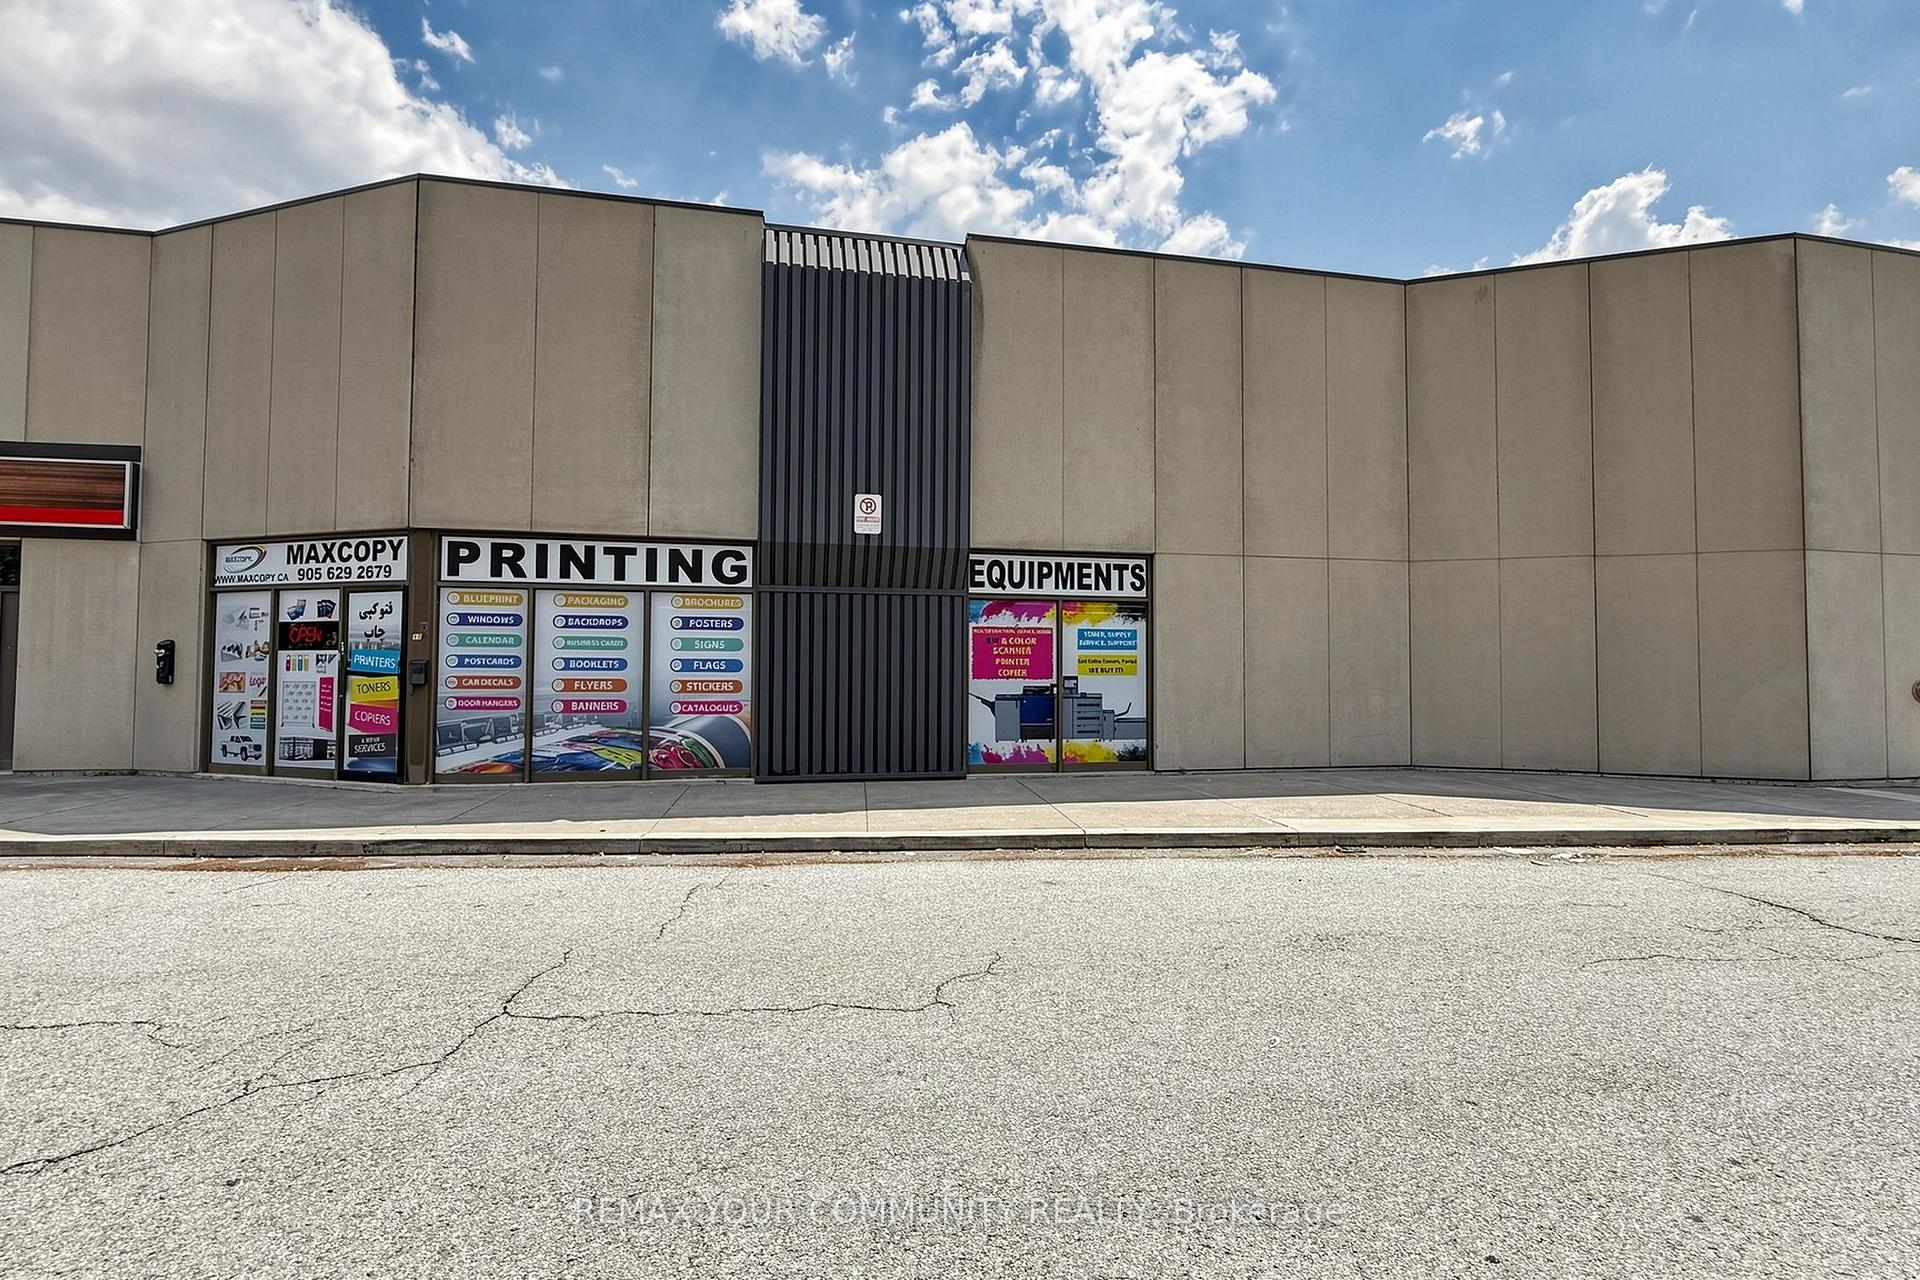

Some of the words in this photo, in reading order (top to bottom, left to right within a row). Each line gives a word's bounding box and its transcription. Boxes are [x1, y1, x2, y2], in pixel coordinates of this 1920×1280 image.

[286, 539, 404, 565] MAXCOPY
[447, 540, 748, 585] PRINTING
[297, 568, 322, 581] 905
[326, 567, 353, 580] 629
[356, 565, 392, 579] 2679
[969, 559, 1146, 592] EQUIPMENTS
[463, 594, 518, 603] BLUEPRINT
[567, 597, 625, 606] PACKAGING
[684, 598, 742, 607] BROCHURES
[467, 615, 514, 624] WINDOWS
[568, 617, 623, 626] BACKDROPS
[689, 619, 733, 628] POSTERS
[465, 636, 514, 645] CALENDAR
[694, 640, 726, 649] SIGNS
[354, 654, 396, 669] PRINTERS
[464, 657, 515, 665] POSTCARDS
[569, 659, 619, 669] BOOKLETS
[693, 660, 726, 670] FLAGS
[357, 681, 392, 694] TONERS
[574, 680, 613, 690] FLYERS
[686, 681, 734, 691] STICKERS
[571, 701, 619, 711] BANNERS
[682, 704, 739, 712] CATALOGUES
[354, 710, 391, 726] COPIERS
[354, 742, 387, 753] SERVICES
